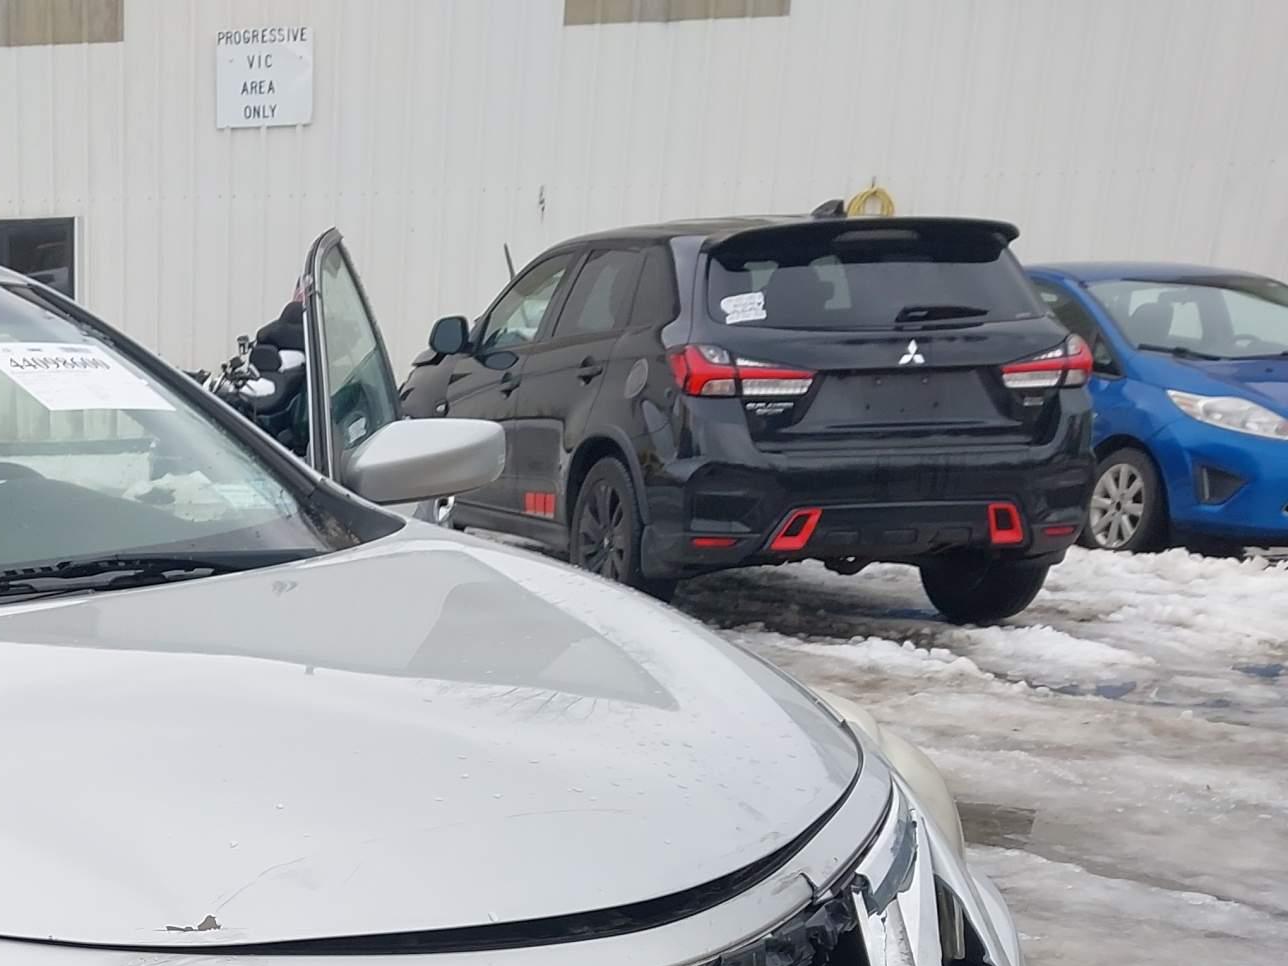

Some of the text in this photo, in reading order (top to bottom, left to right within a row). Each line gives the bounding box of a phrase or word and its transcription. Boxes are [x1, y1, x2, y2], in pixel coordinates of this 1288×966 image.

[217, 27, 307, 45] PROGRESSIVE
[247, 54, 273, 69] VIC
[240, 80, 275, 95] AREA
[243, 104, 277, 119] ONLY
[9, 356, 111, 370] 44098600
